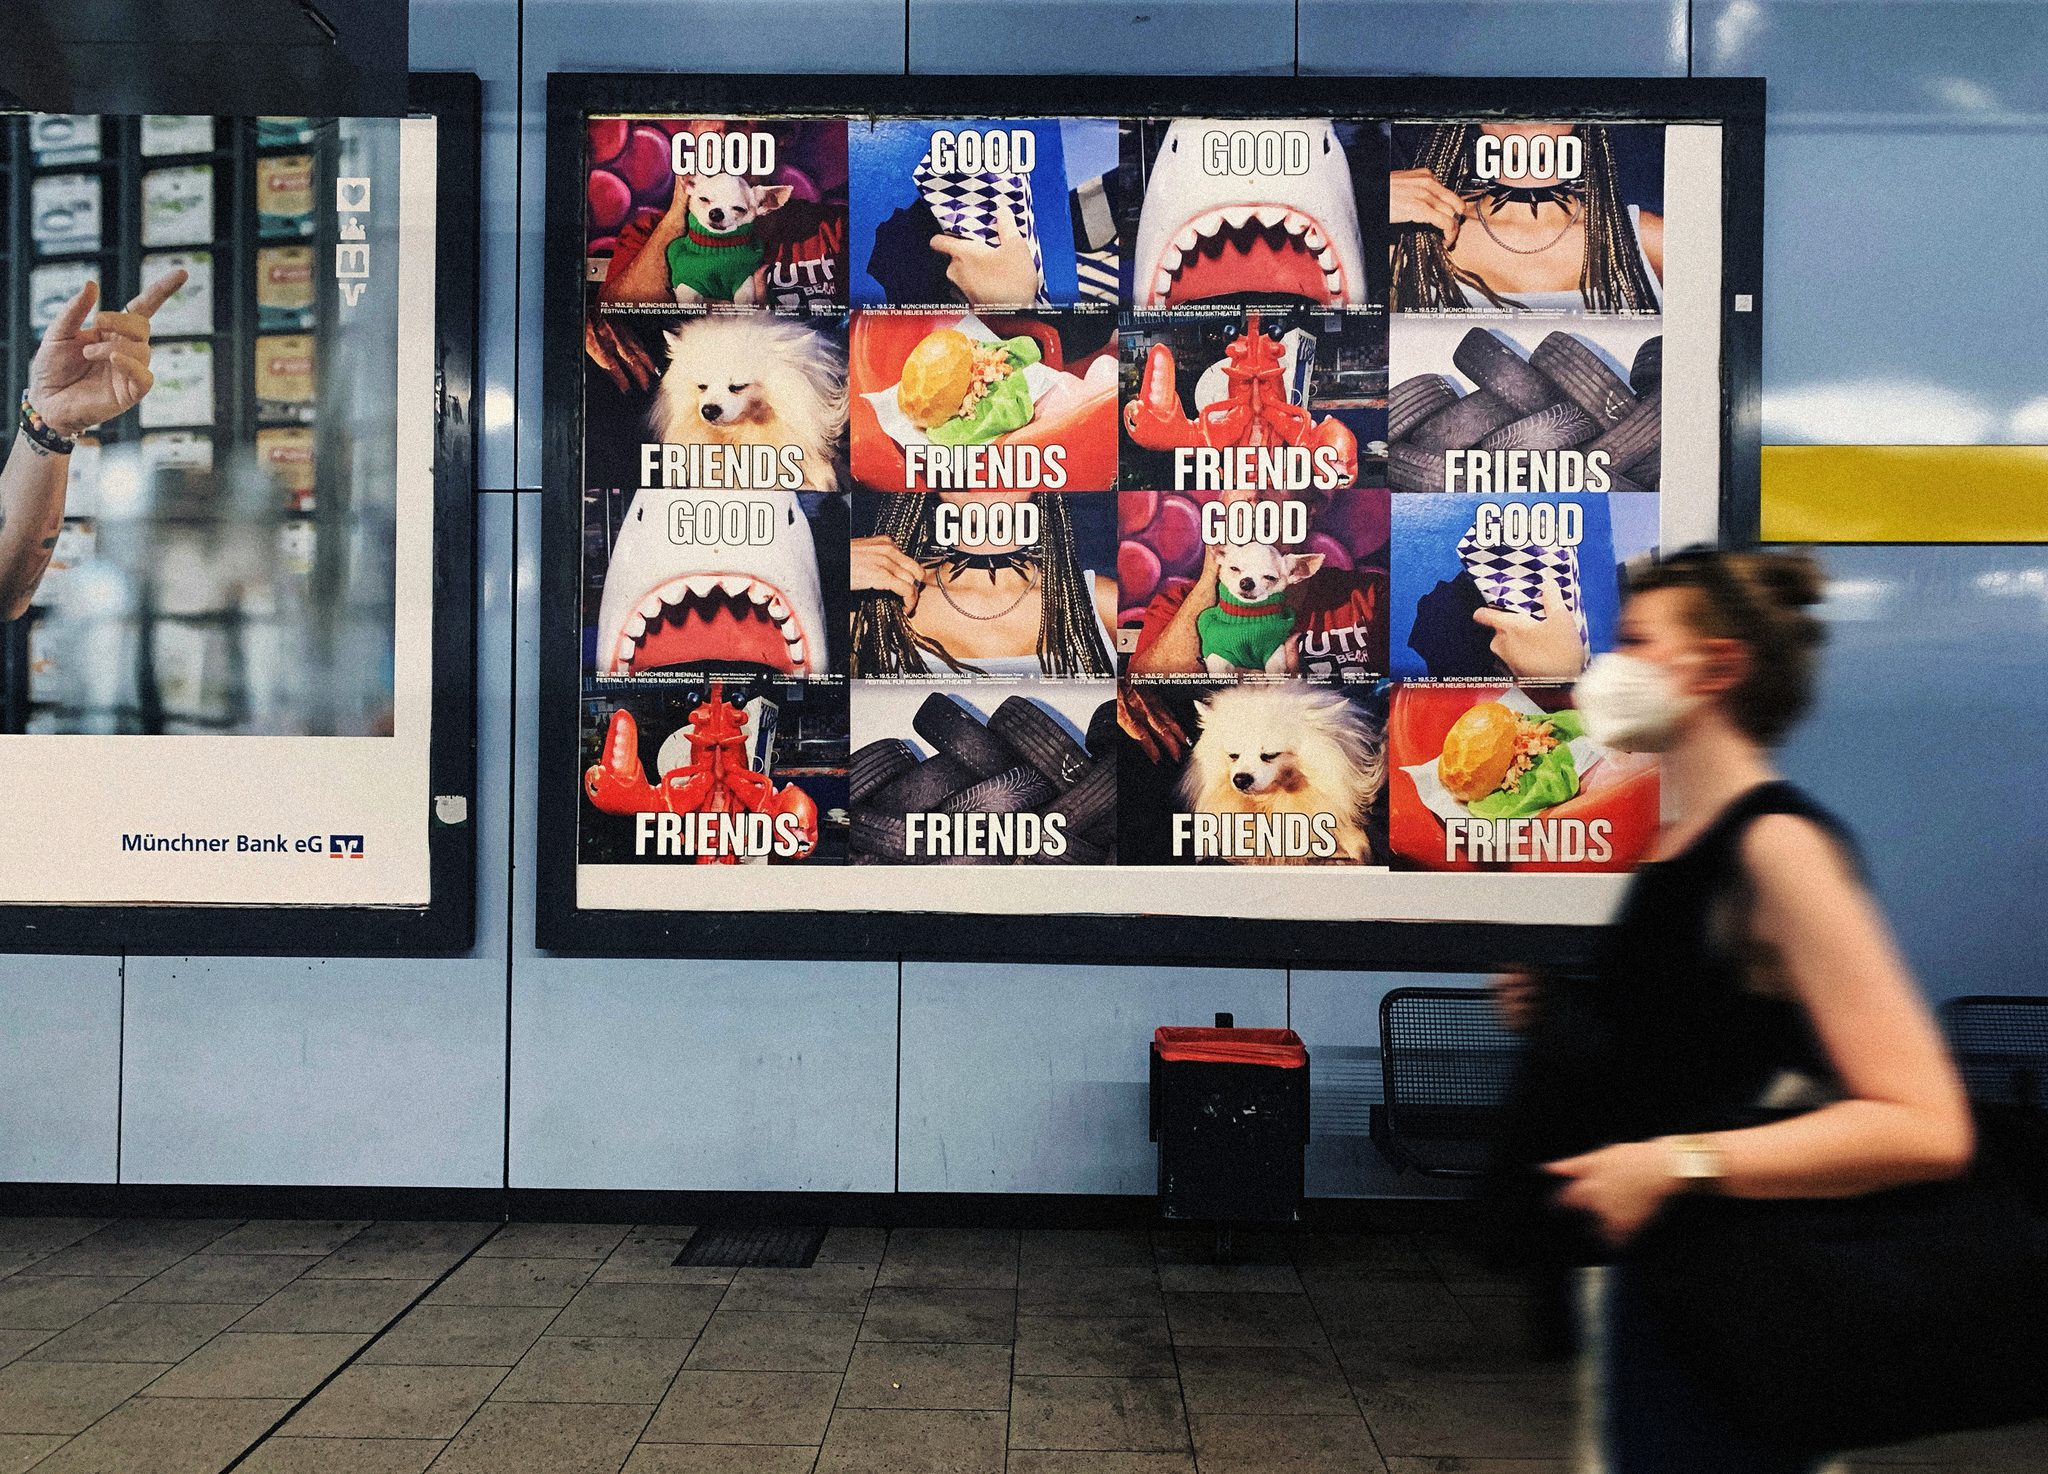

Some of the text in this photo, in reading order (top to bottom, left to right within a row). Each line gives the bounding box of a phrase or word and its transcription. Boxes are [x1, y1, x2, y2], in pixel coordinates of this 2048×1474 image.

[671, 131, 776, 176] GOOD
[930, 129, 1036, 174] GOOD
[1202, 130, 1310, 176] GOOD
[1476, 134, 1582, 180] GOOD
[640, 442, 803, 488] FRIENDS
[906, 443, 1068, 488] FRIENDS
[1174, 446, 1338, 491] FRIENDS
[1445, 448, 1611, 494] FRIENDS
[668, 500, 775, 546] GOOD
[935, 502, 1040, 547] GOOD
[1200, 500, 1308, 546] GOOD
[1476, 501, 1584, 547] GOOD
[122, 834, 322, 852] Münchner Bank eG
[636, 811, 800, 857] FRIENDS
[906, 811, 1068, 856] FRIENDS
[1172, 812, 1336, 857] FRIENDS
[1446, 817, 1612, 862] FRIENDS
